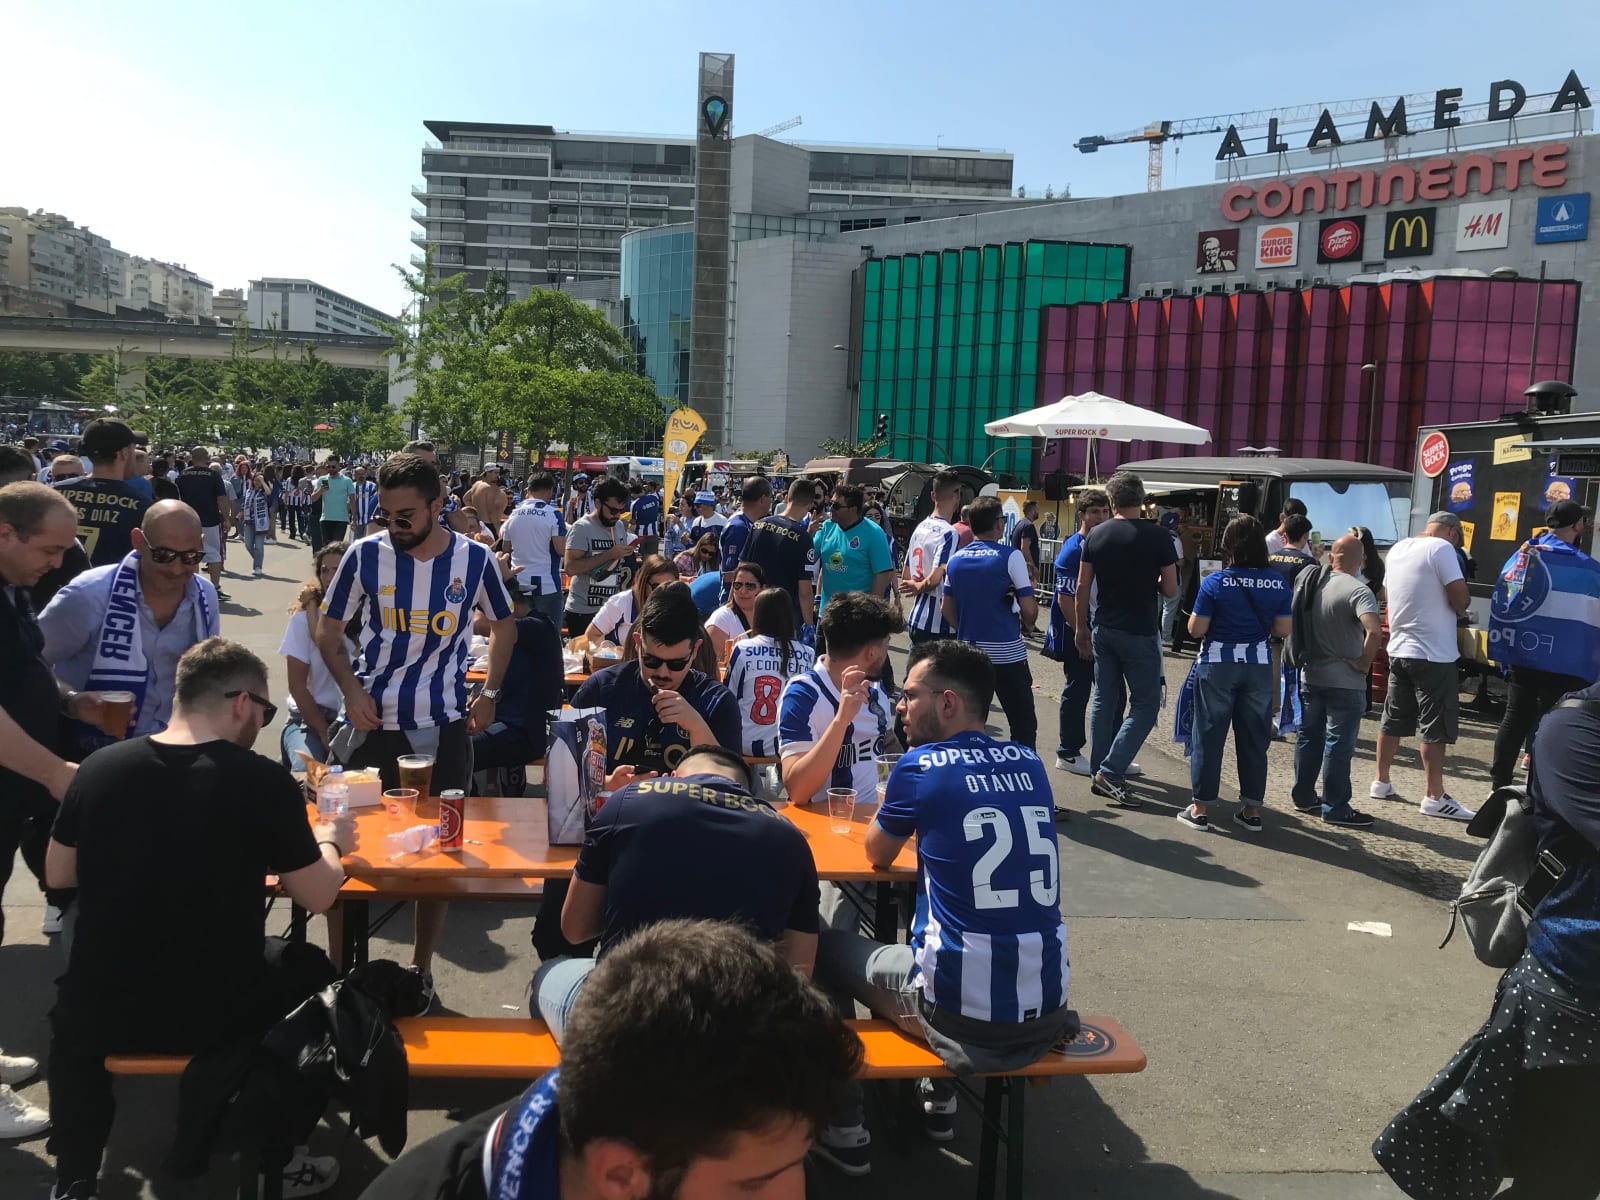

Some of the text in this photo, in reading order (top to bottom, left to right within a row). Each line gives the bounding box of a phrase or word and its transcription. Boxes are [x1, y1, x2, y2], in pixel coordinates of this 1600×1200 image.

[1215, 69, 1592, 161] ALAMEDA
[1220, 143, 1569, 223] CONTINENTE
[1463, 212, 1503, 238] H&M
[1260, 246, 1292, 257] KING
[1261, 238, 1293, 247] BURGER
[1328, 235, 1352, 249] Pizza
[1332, 242, 1348, 252] Hut
[1220, 249, 1236, 257] KFC
[1055, 428, 1076, 436] SUPER
[1422, 440, 1445, 459] SUPER
[1424, 450, 1446, 468] BOCK
[60, 489, 139, 510] UPER BOCK
[91, 509, 120, 523] DIAZ
[753, 521, 800, 541] SUPER BOCK
[1283, 556, 1304, 564] BOCK
[1222, 577, 1284, 590] SUPER BOCK
[100, 566, 137, 662] VENCER
[382, 606, 458, 636] MEO
[745, 646, 813, 662] SUPER BOCK
[750, 675, 782, 726] 8
[918, 748, 989, 772] SUPER
[965, 767, 1034, 793] OTÁVIO
[637, 781, 717, 804] SUPER
[441, 808, 450, 838] BOCK
[962, 805, 1058, 910] 25
